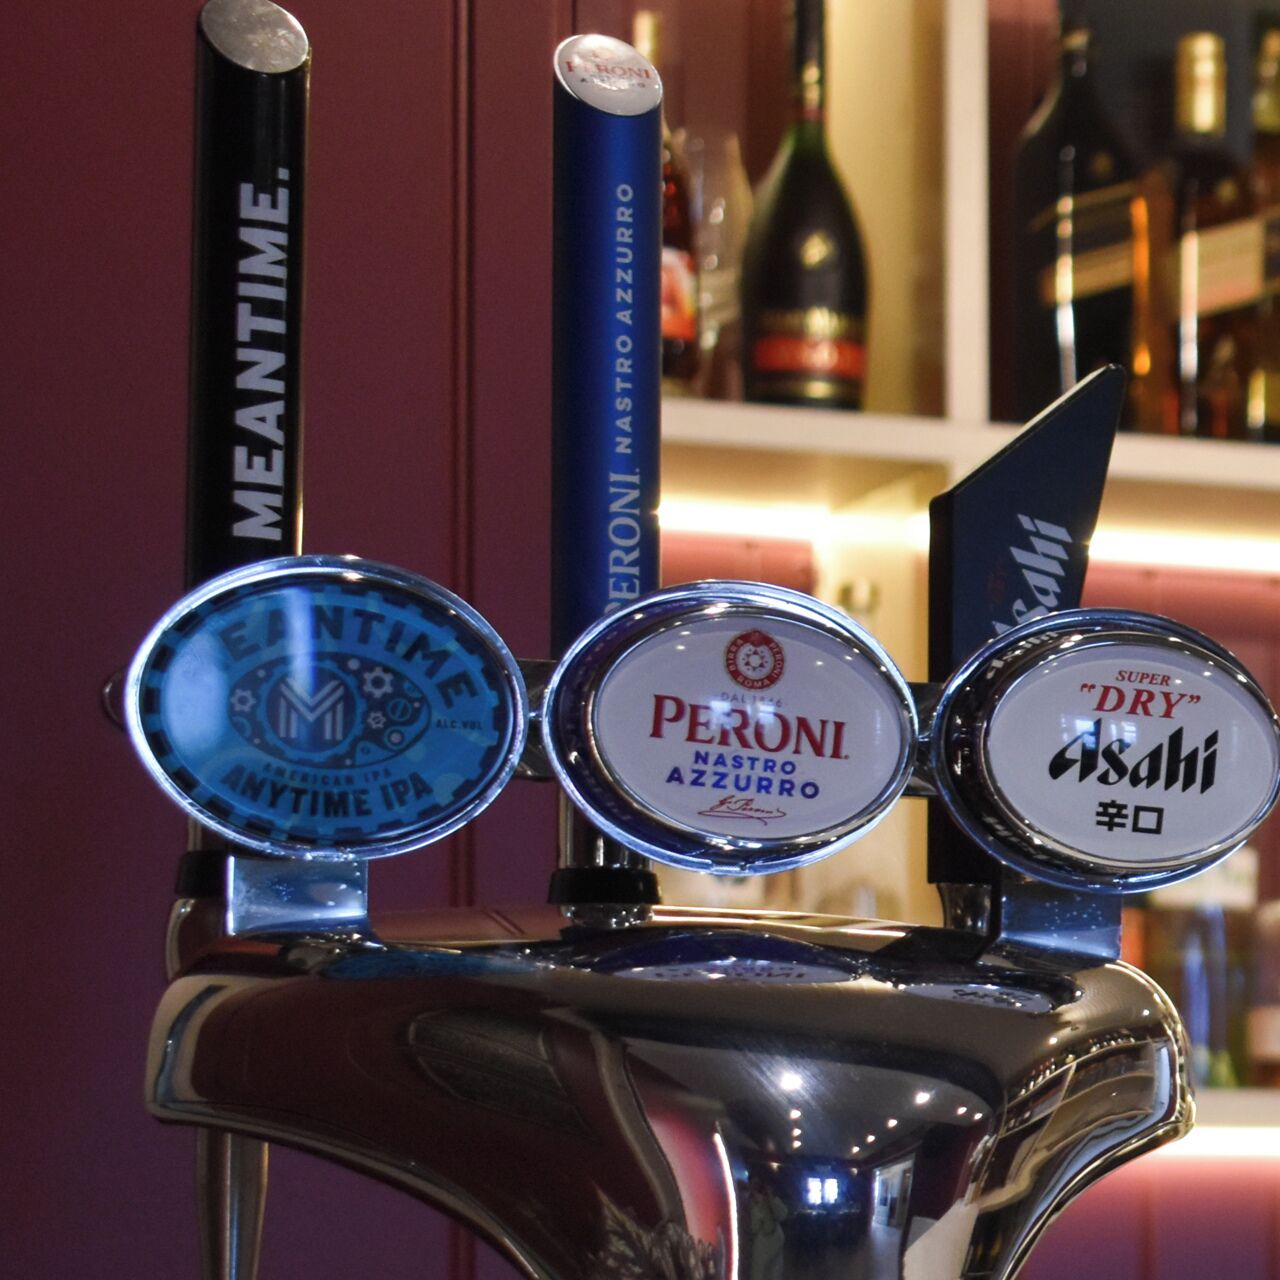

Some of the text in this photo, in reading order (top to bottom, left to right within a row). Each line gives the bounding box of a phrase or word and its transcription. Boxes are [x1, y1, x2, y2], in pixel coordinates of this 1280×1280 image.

[566, 61, 650, 79] RONI
[615, 183, 634, 322] AZZURRO
[232, 167, 290, 541] MEANTIME.
[615, 334, 633, 455] NASTRO
[992, 513, 1073, 636] sahi
[217, 606, 480, 710] EANTIME
[1116, 670, 1171, 686] SUPER
[737, 675, 771, 688] ROMA
[263, 763, 392, 787] AMERICAN IPA
[695, 750, 797, 776] NASTRO
[1048, 718, 1219, 794] Asahi
[221, 764, 433, 817] ANYTIME IPA
[665, 766, 820, 799] AZZURRO
[1095, 800, 1164, 834] 辛口
